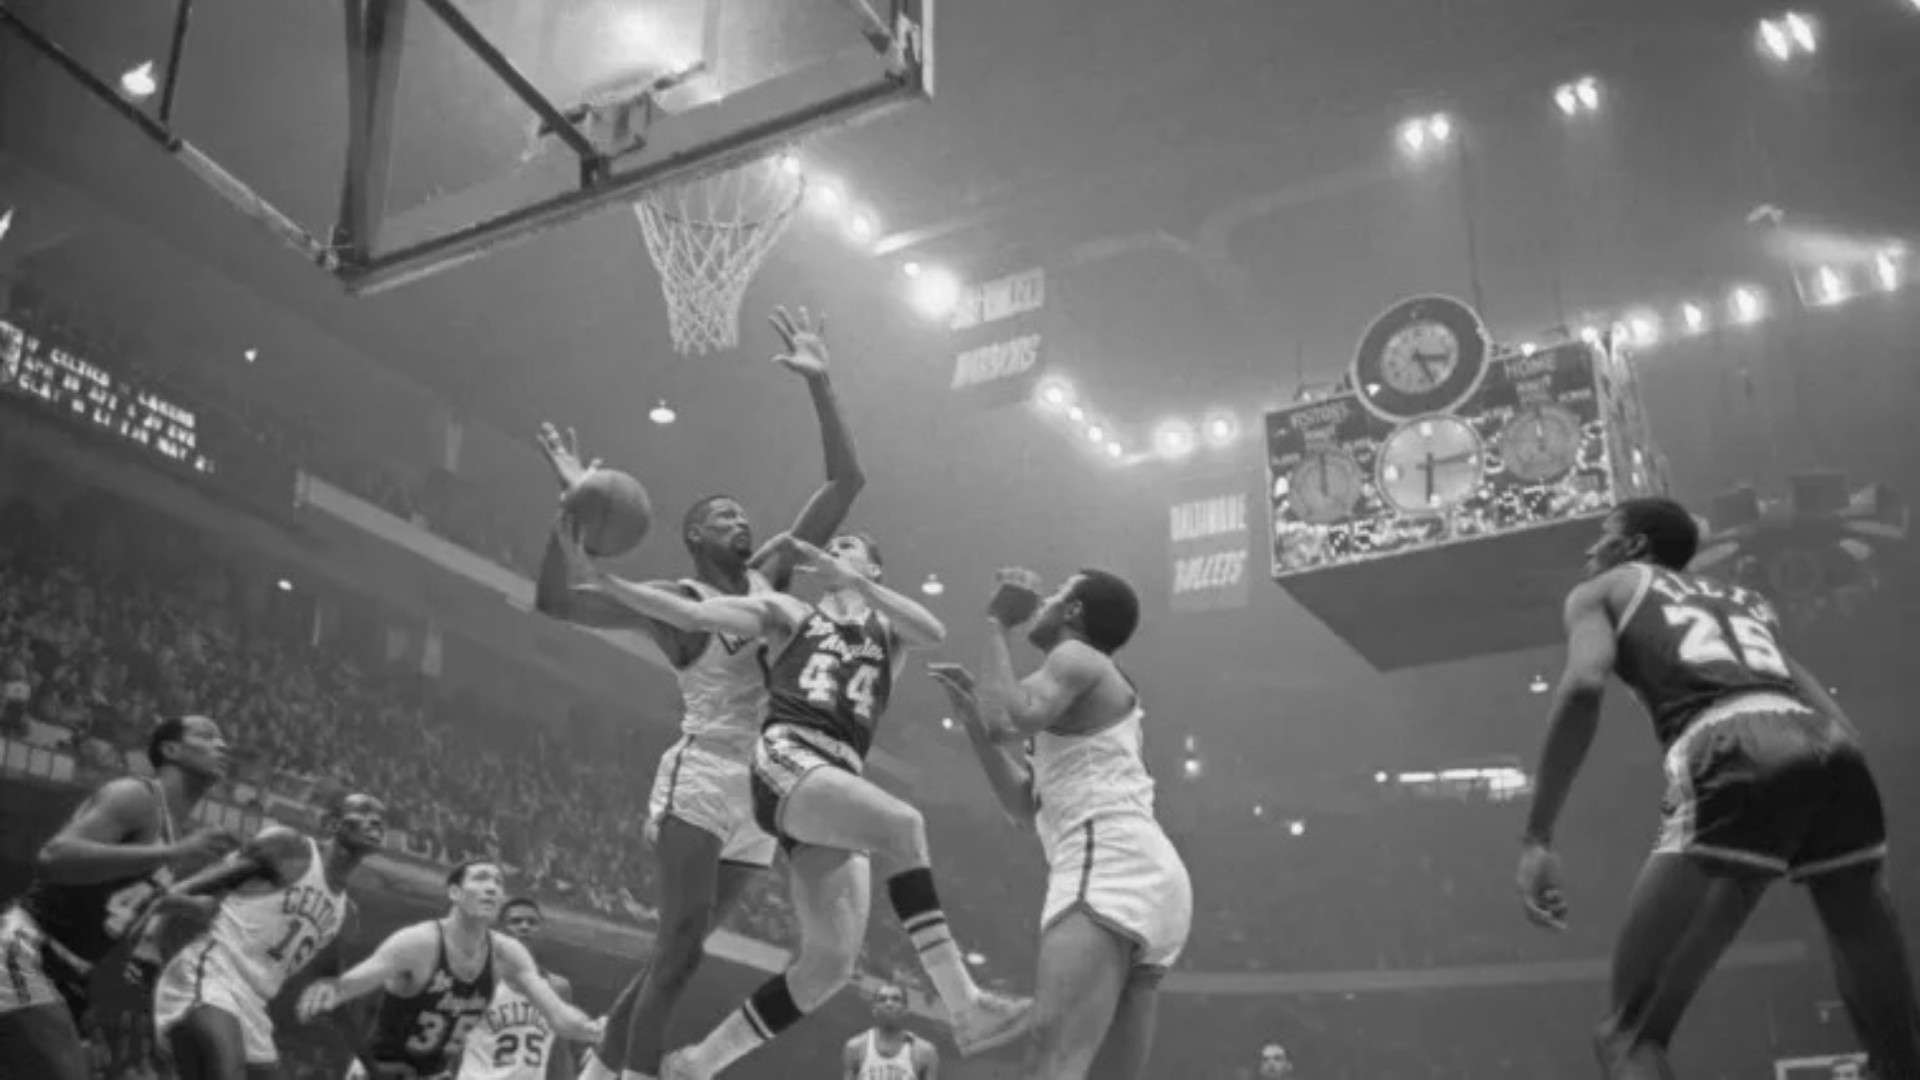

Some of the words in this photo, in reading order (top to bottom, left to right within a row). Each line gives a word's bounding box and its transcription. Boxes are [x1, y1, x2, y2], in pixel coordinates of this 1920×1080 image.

[1661, 604, 1791, 679] 25
[798, 652, 881, 719] 44
[492, 1033, 544, 1069] 25
